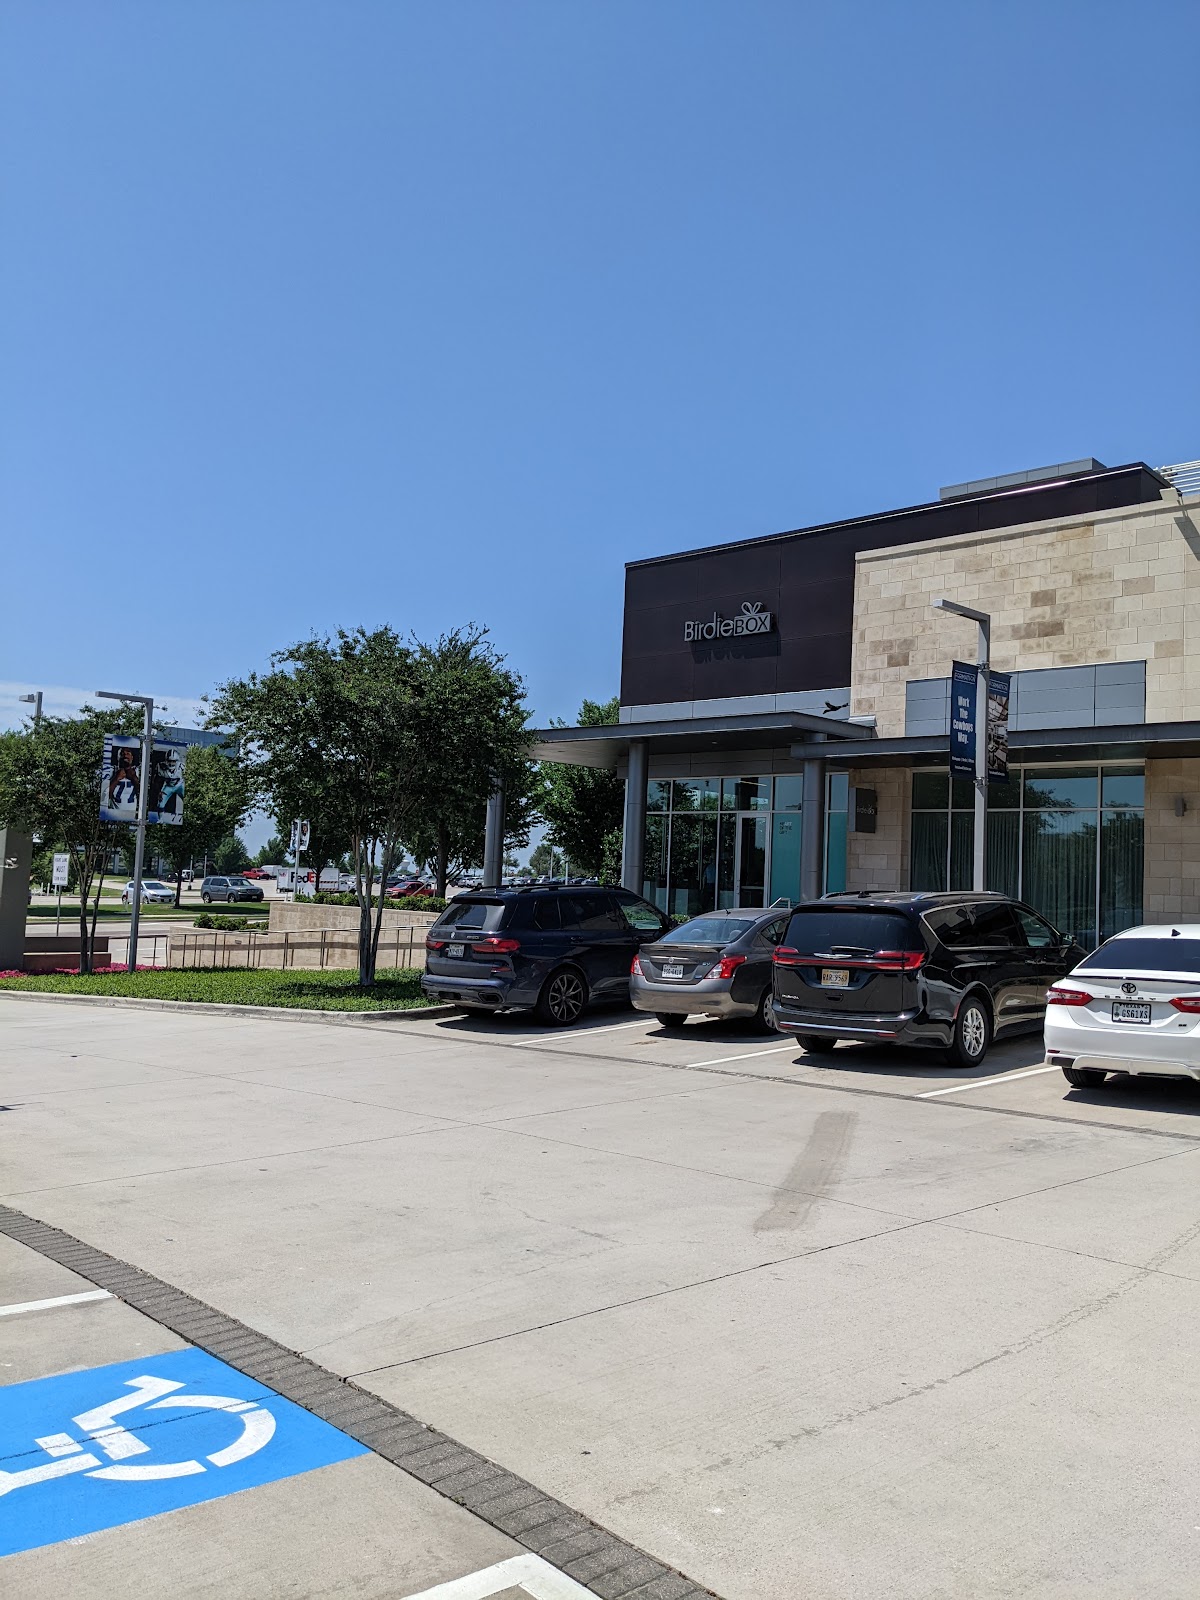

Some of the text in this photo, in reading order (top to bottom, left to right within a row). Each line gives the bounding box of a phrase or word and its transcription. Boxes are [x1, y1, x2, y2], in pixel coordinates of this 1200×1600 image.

[684, 611, 772, 642] BirdieBOX
[958, 696, 969, 707] Work
[960, 708, 968, 719] The
[953, 720, 973, 732] Cowboys
[958, 732, 969, 744] Way.
[1121, 1009, 1149, 1019] GS61XS
